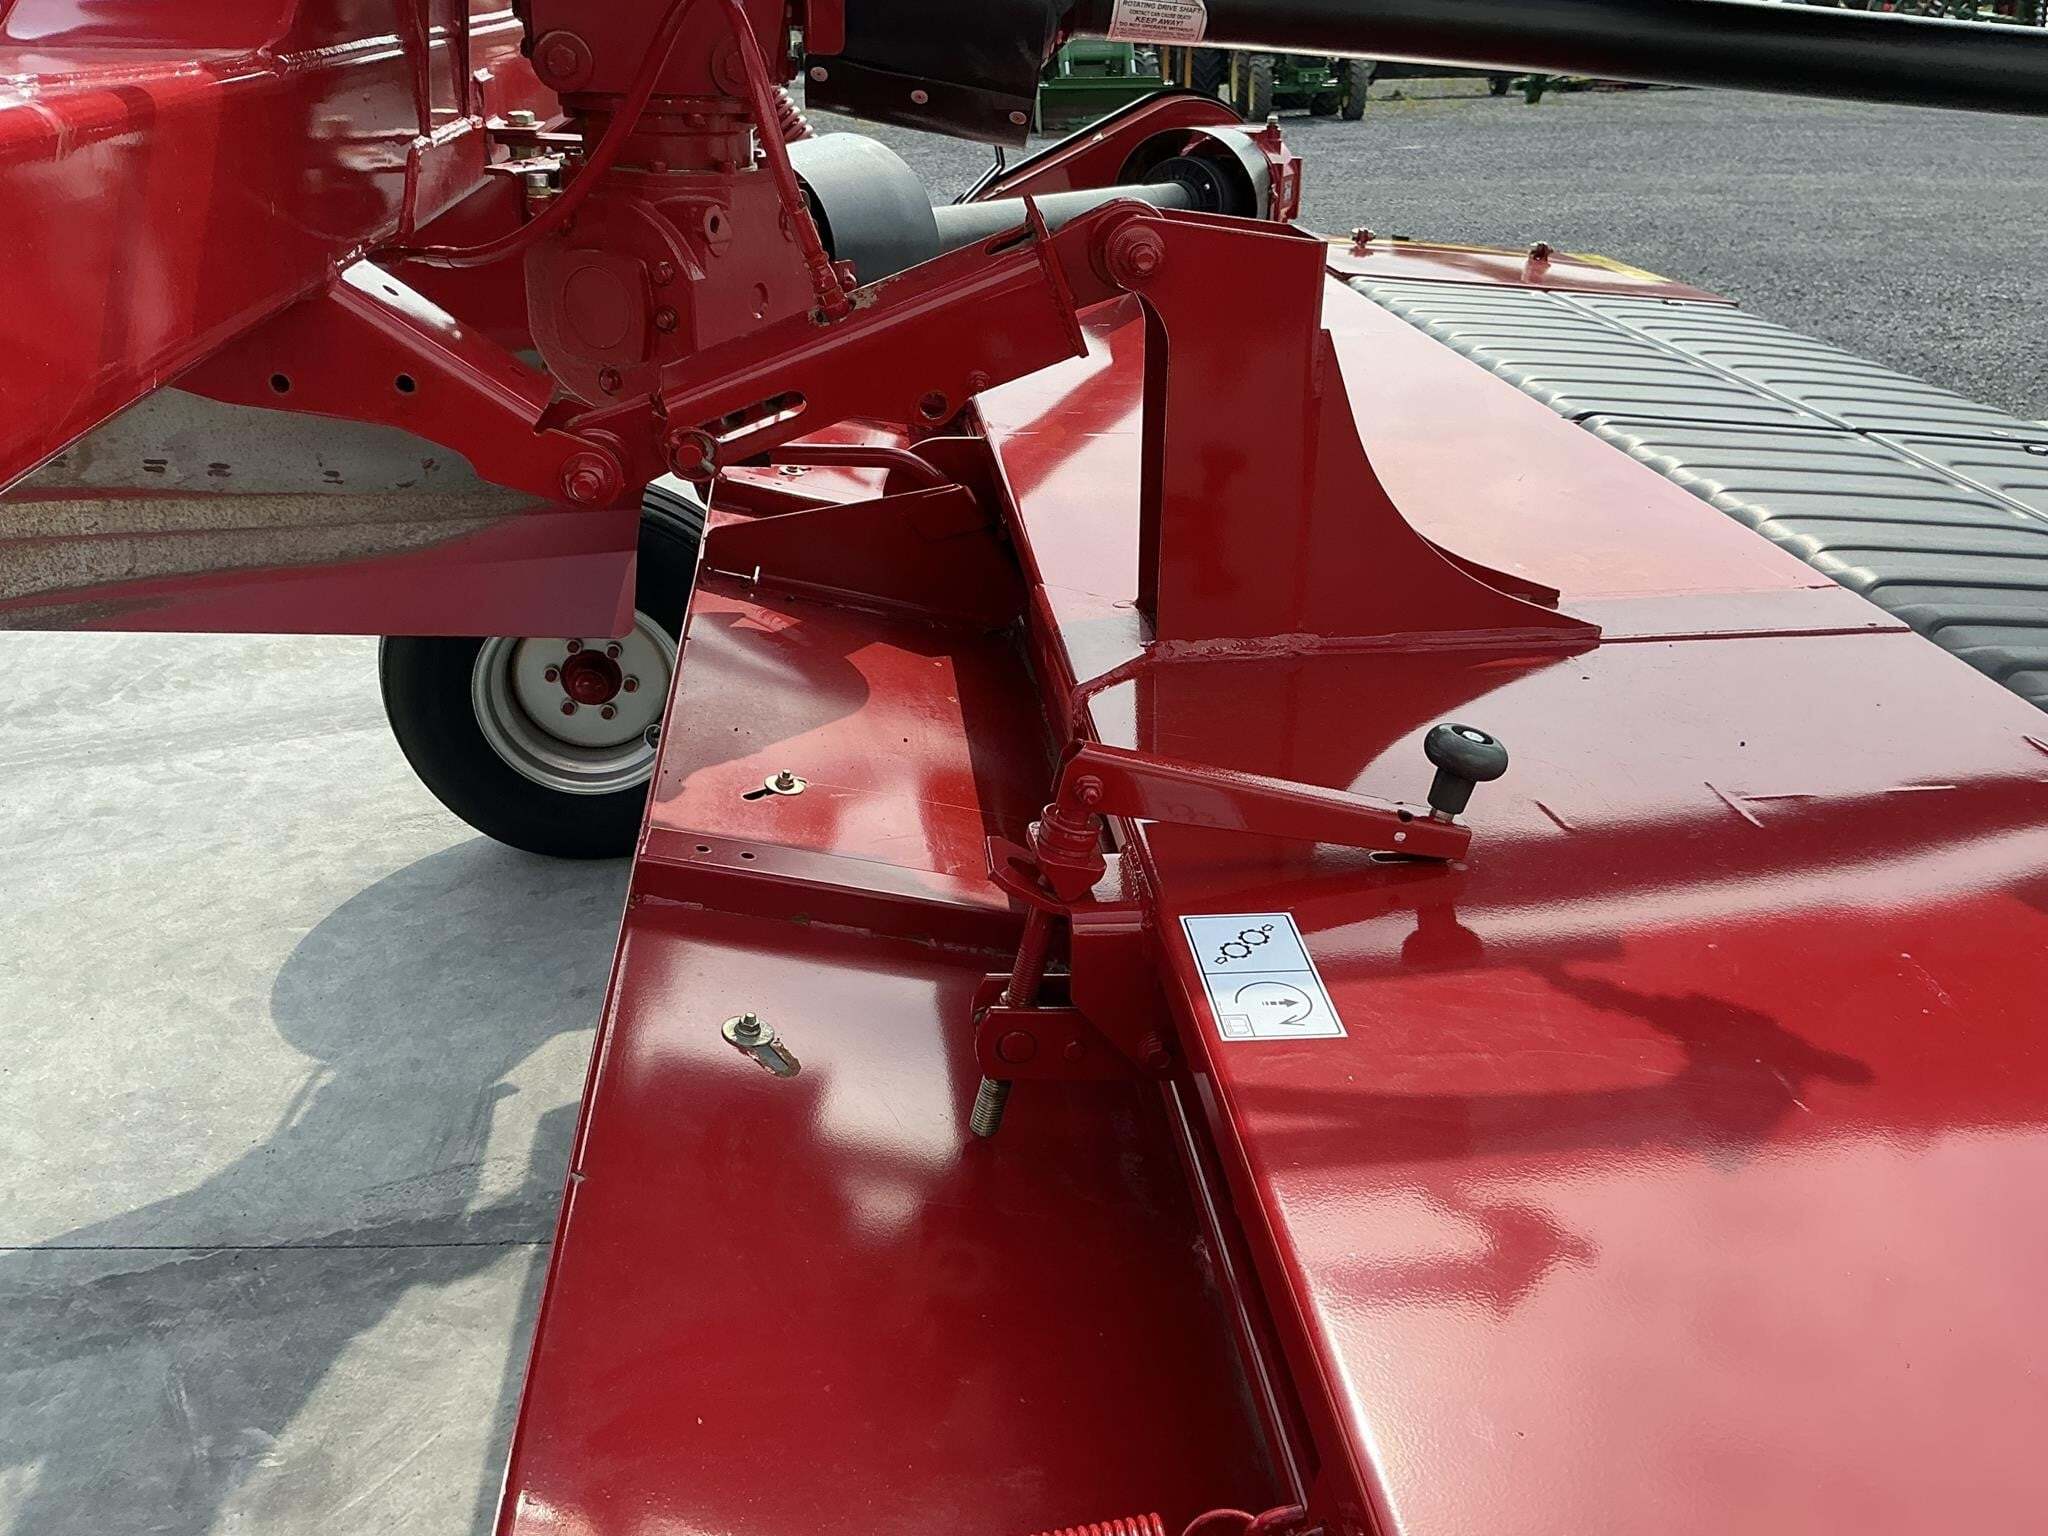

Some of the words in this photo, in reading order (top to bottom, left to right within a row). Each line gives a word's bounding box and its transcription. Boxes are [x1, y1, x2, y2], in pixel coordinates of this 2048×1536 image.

[1122, 0, 1155, 9] ROTATING
[1179, 6, 1203, 14] SHAFT
[1135, 16, 1157, 24] KEEP
[1158, 18, 1184, 26] AWAY!
